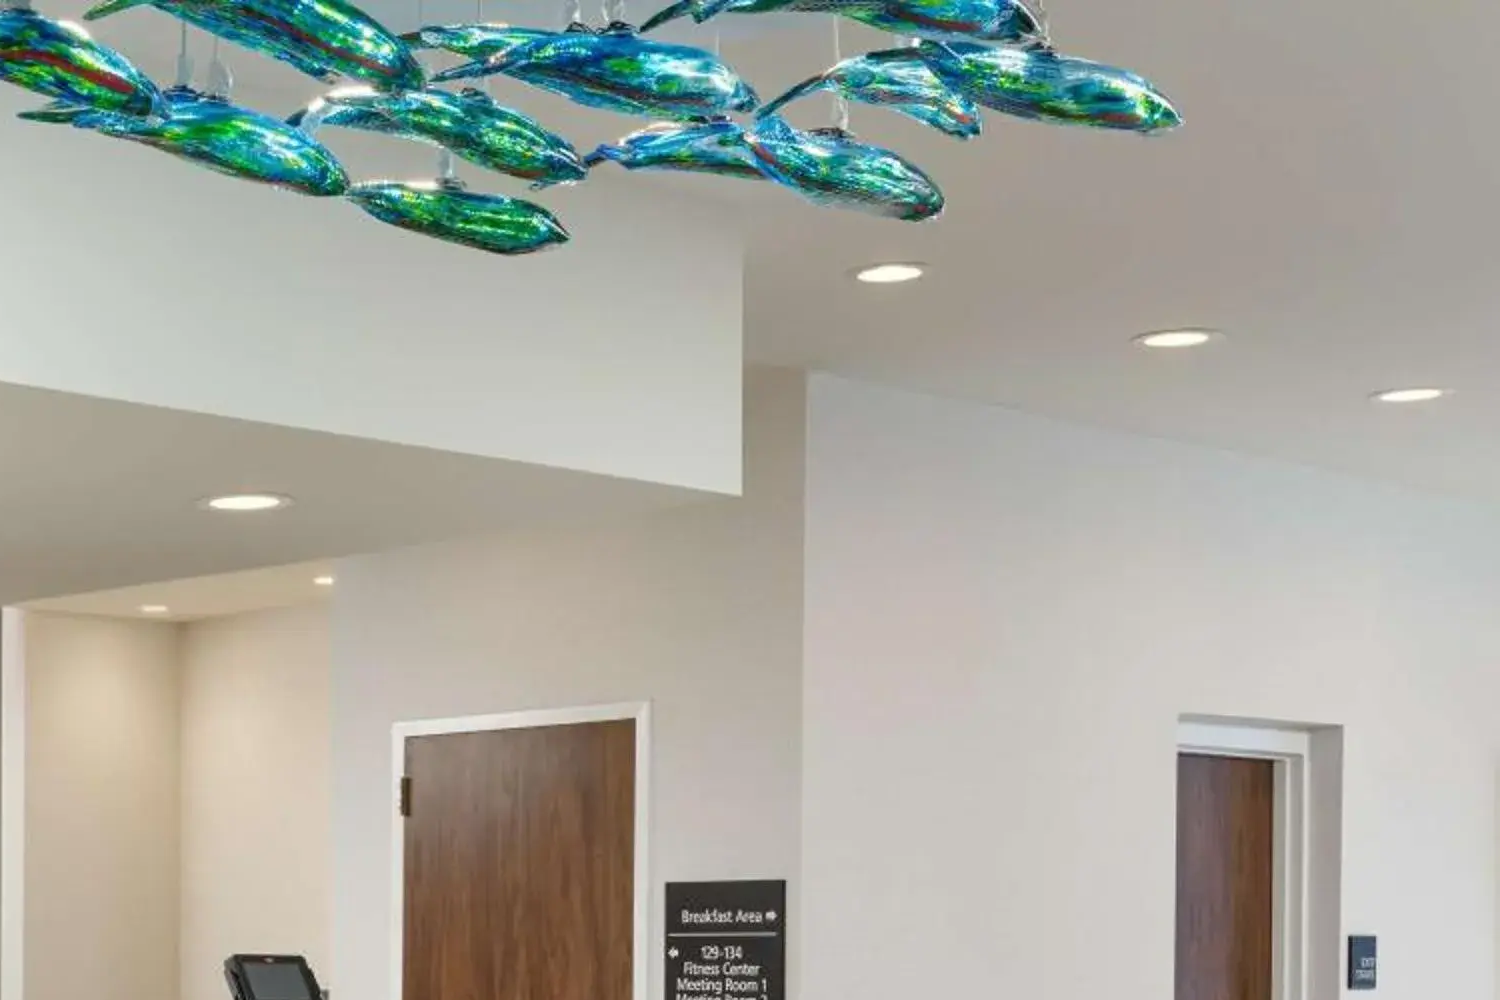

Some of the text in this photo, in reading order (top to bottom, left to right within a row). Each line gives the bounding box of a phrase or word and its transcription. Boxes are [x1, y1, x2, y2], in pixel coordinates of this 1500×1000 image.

[681, 909, 763, 923] Breakfast Area
[701, 945, 743, 960] 129-134
[683, 961, 760, 976] Fitness Center
[676, 977, 767, 994] Meeting Room 1
